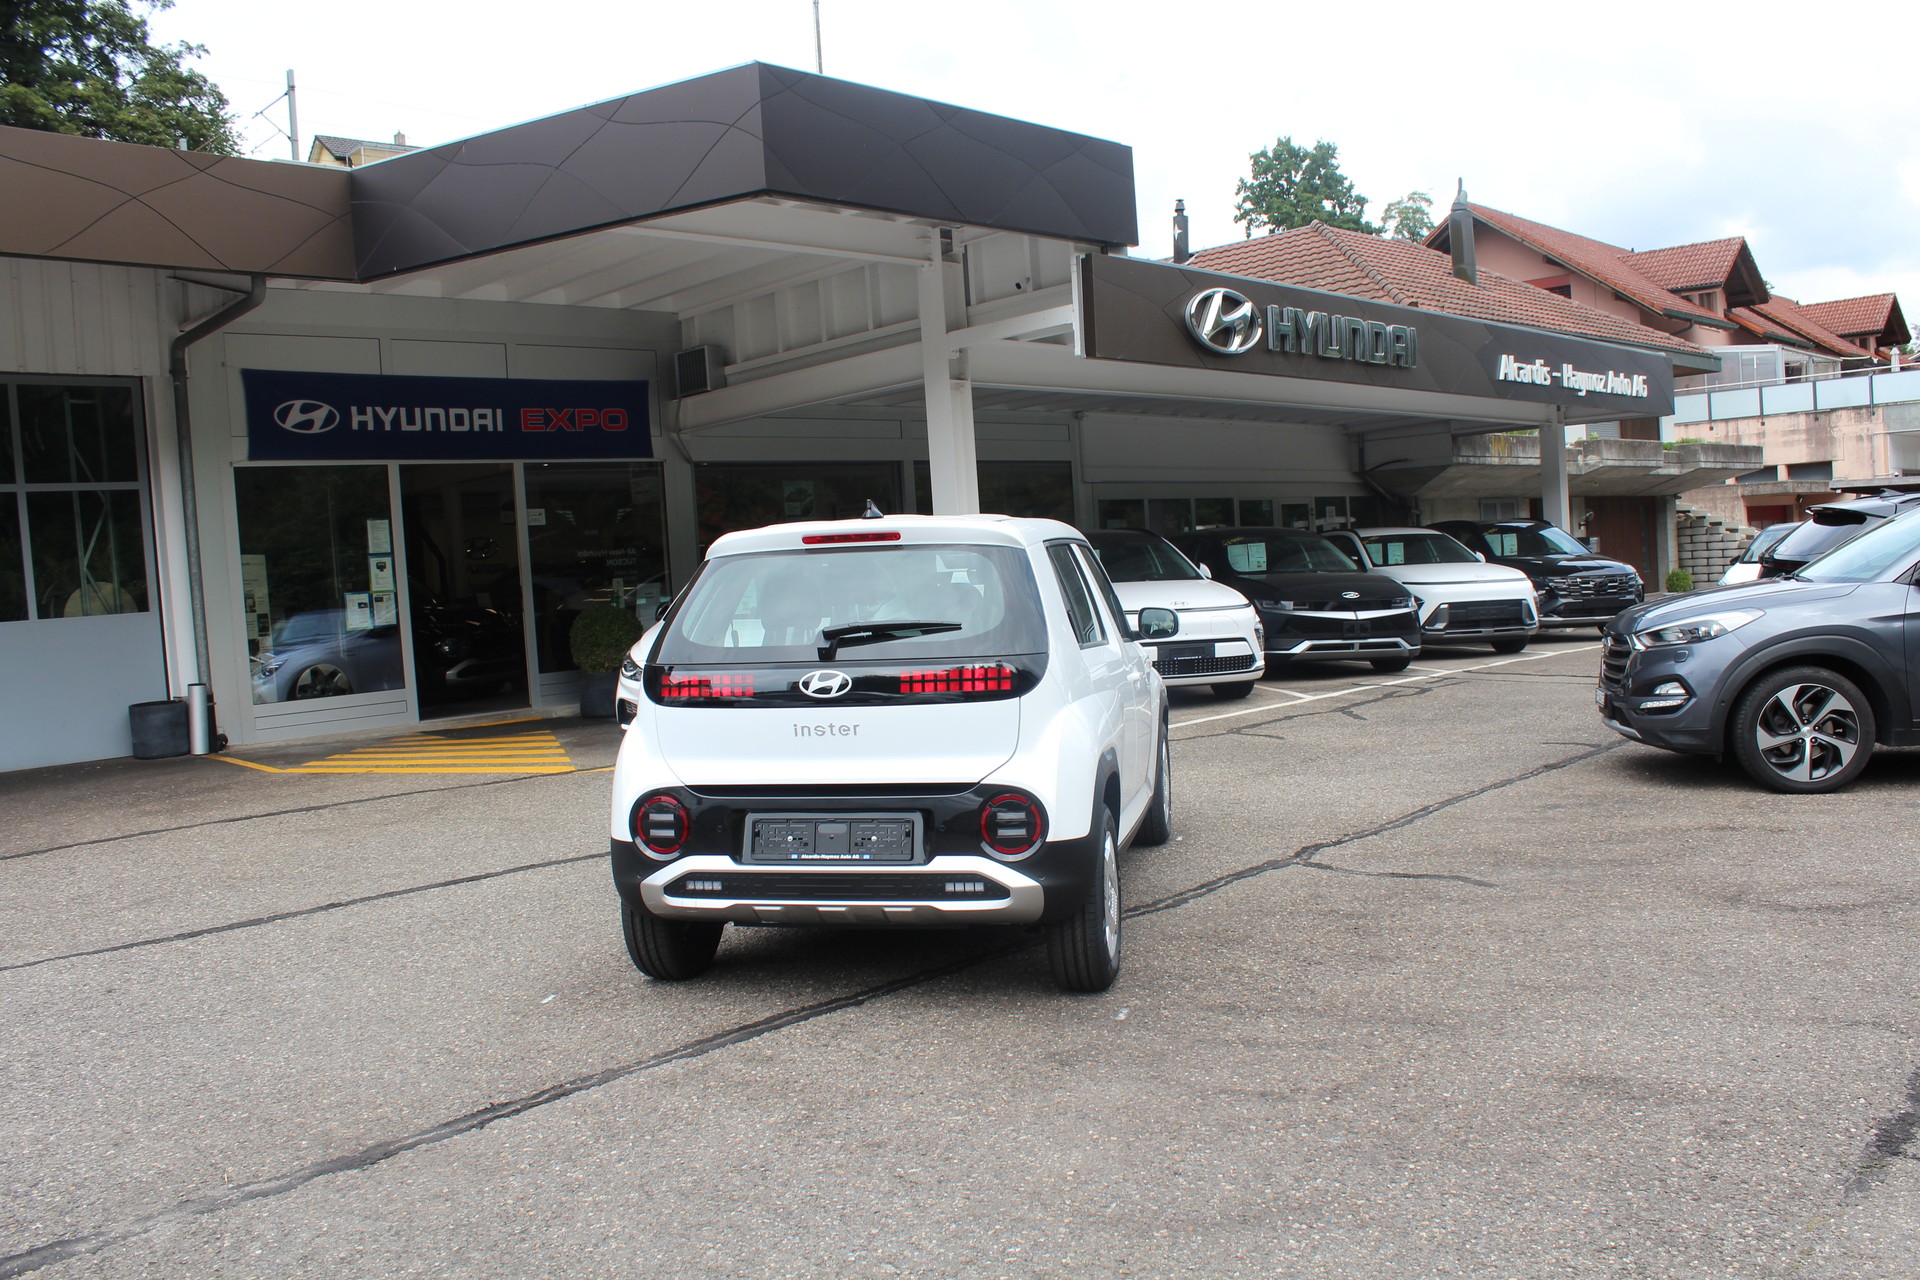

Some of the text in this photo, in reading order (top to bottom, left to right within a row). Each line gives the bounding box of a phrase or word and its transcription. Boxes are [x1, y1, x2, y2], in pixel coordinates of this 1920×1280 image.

[1266, 304, 1417, 368] HYUNDAI
[1562, 363, 1607, 396] Haymoz
[1607, 370, 1632, 396] Auto
[1632, 375, 1648, 398] AG
[351, 405, 629, 432] HYUNDAI EXPO
[793, 722, 860, 737] inster
